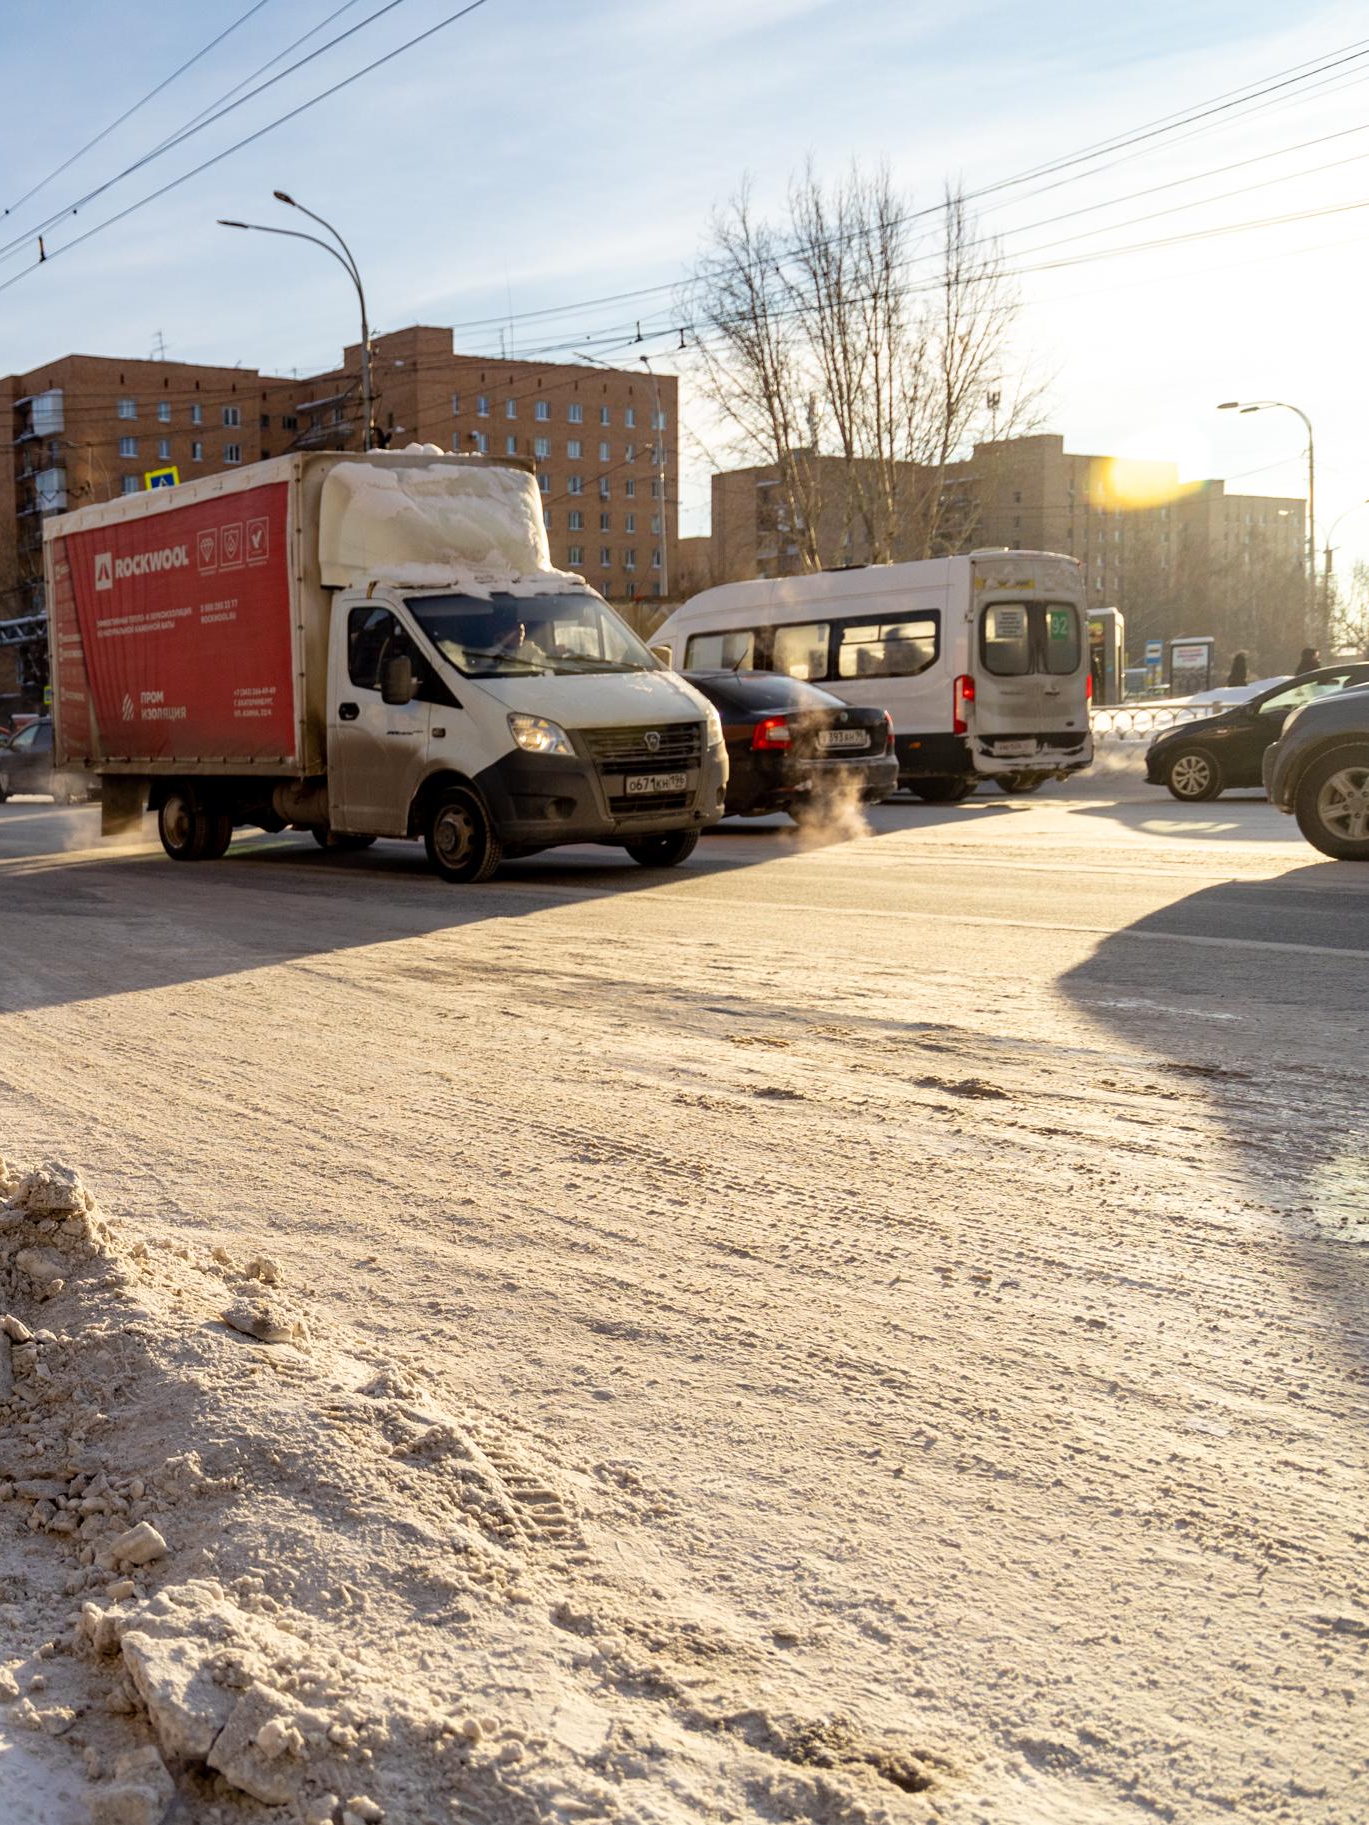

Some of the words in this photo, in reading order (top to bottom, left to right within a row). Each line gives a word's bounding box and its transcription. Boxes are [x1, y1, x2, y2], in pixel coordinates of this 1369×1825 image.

[115, 544, 190, 579] ROCKWOOL
[140, 691, 164, 704] ПРОМ
[141, 706, 187, 722] ИЗОЛЯЦИЯ
